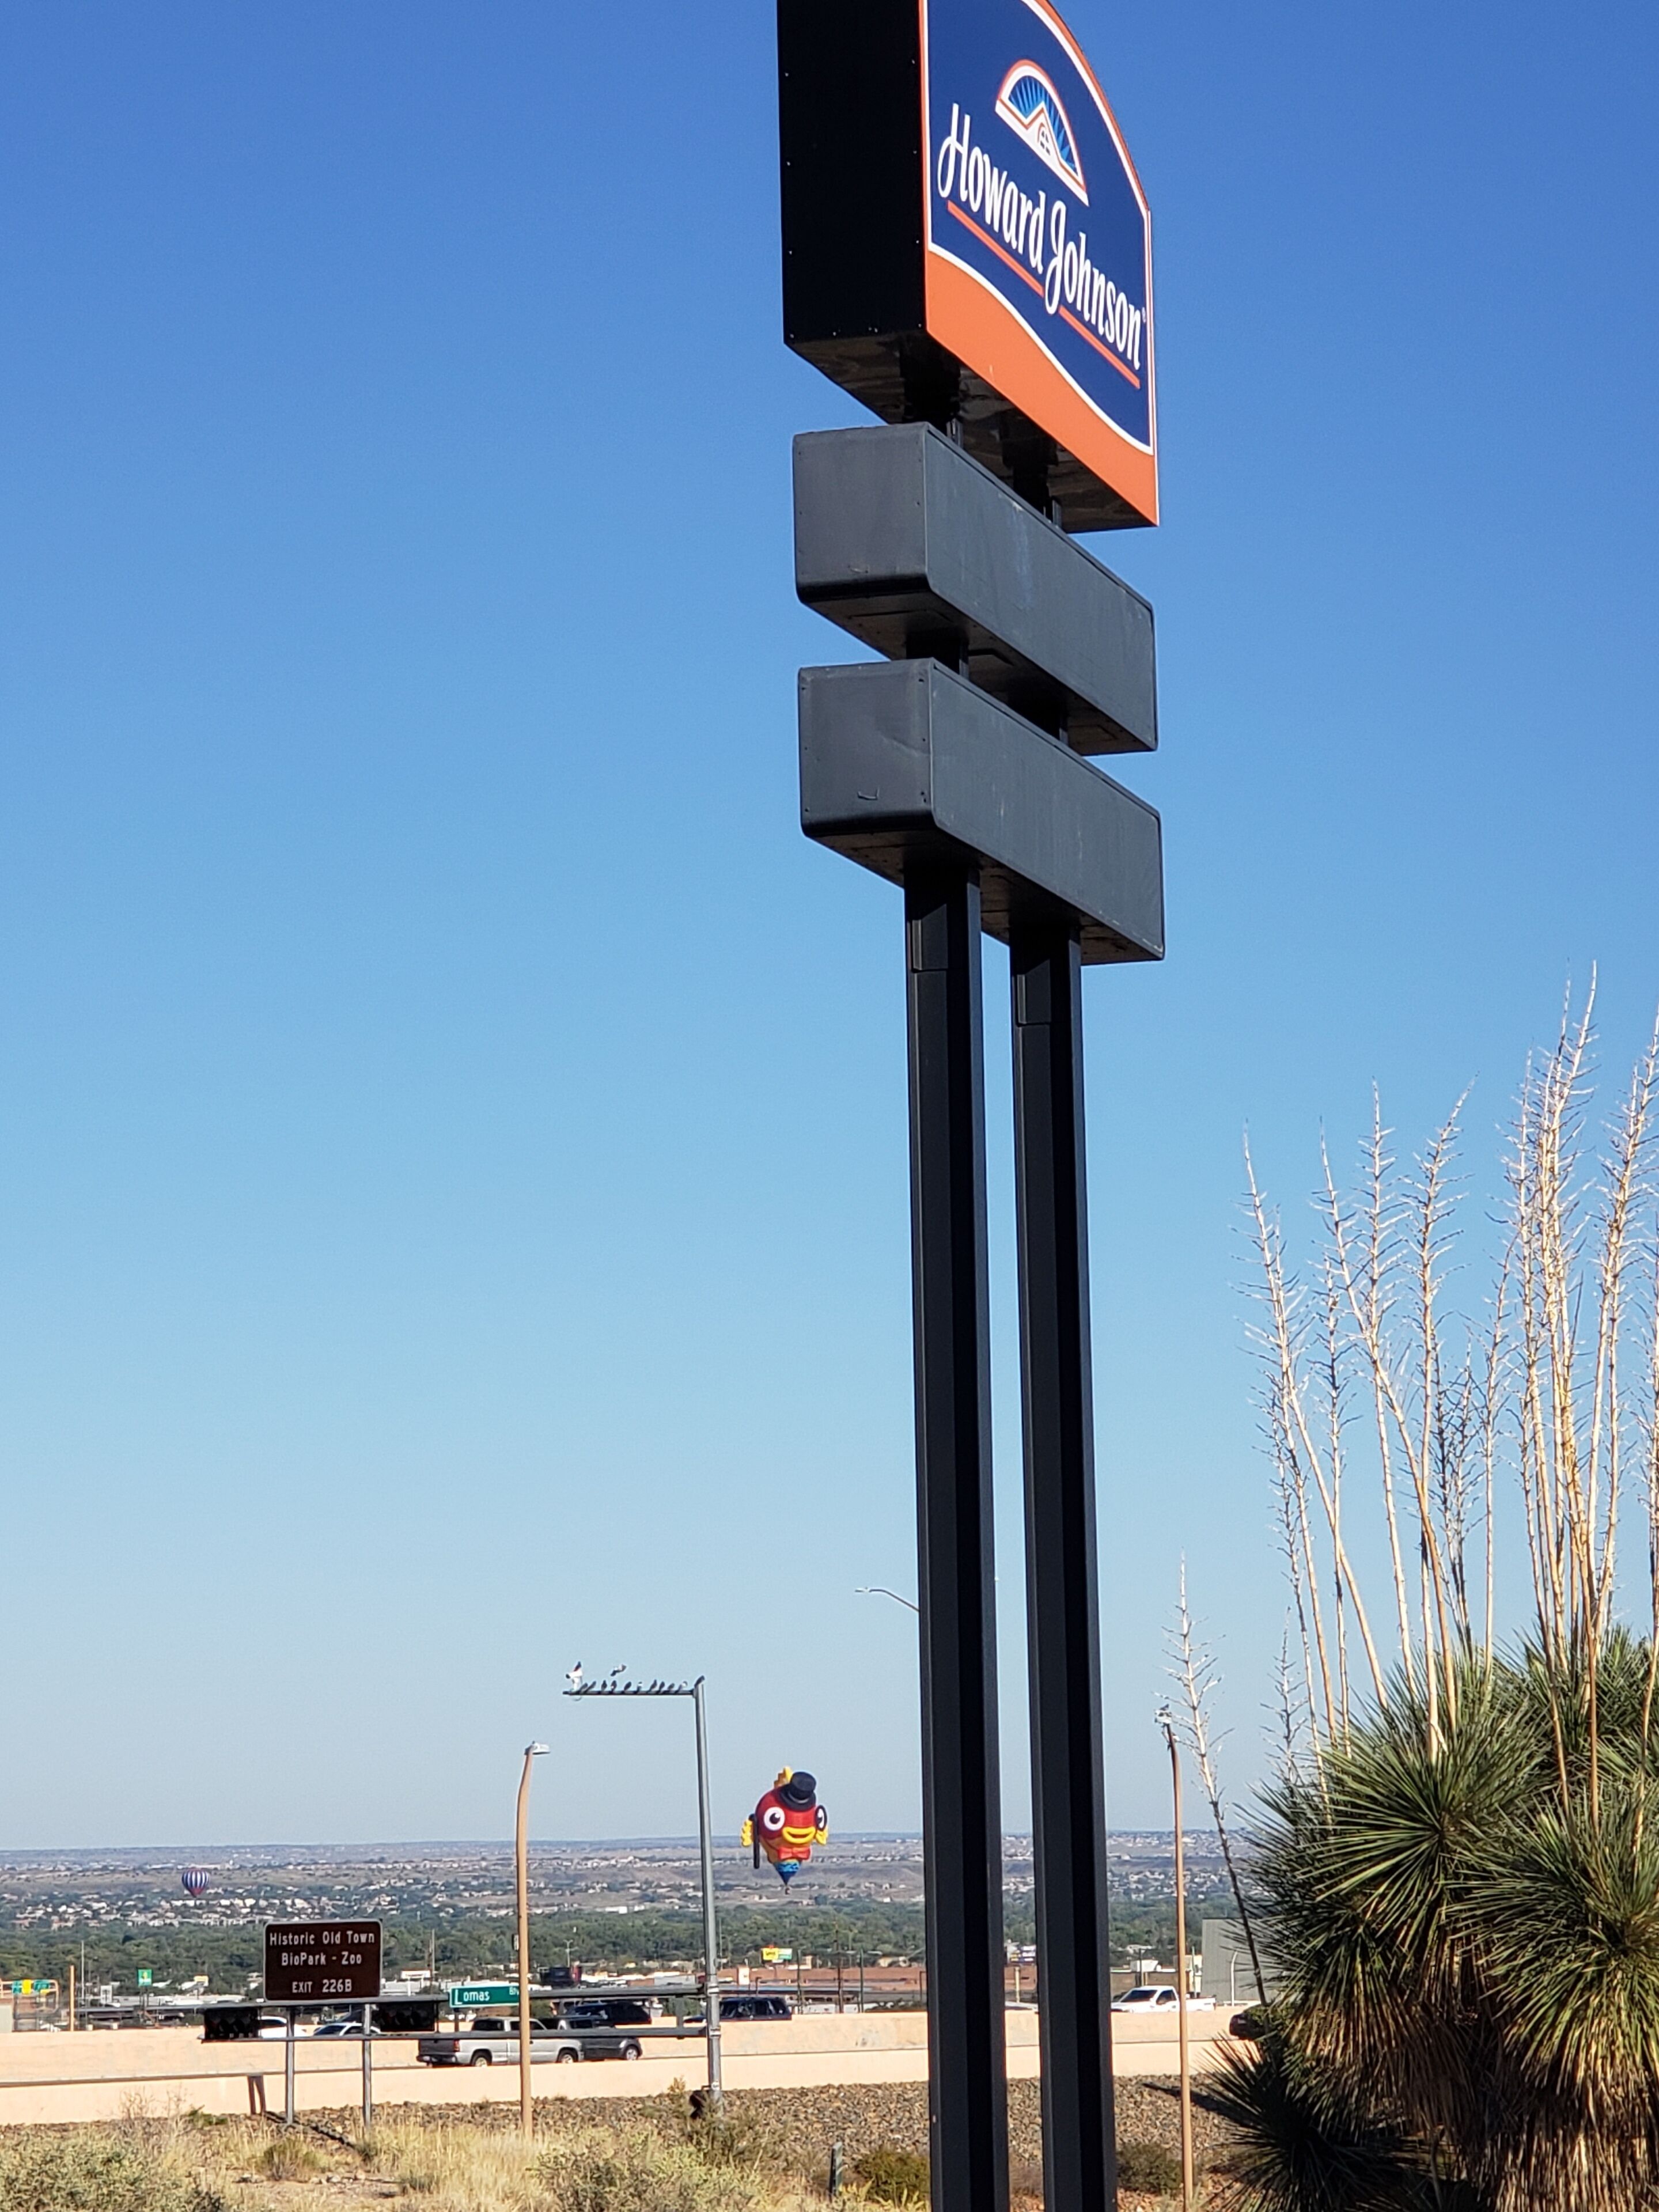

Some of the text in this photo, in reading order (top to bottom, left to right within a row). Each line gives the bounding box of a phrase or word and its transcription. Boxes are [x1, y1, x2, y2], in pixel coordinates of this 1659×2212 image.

[938, 103, 1141, 370] Howard Johnson
[270, 1930, 374, 1946] Historic Old Town
[281, 1952, 326, 1967] BioPark
[341, 1951, 362, 1965] Zoo
[292, 1979, 352, 1994] EXIT 226B
[454, 1989, 490, 2005] Lomas
